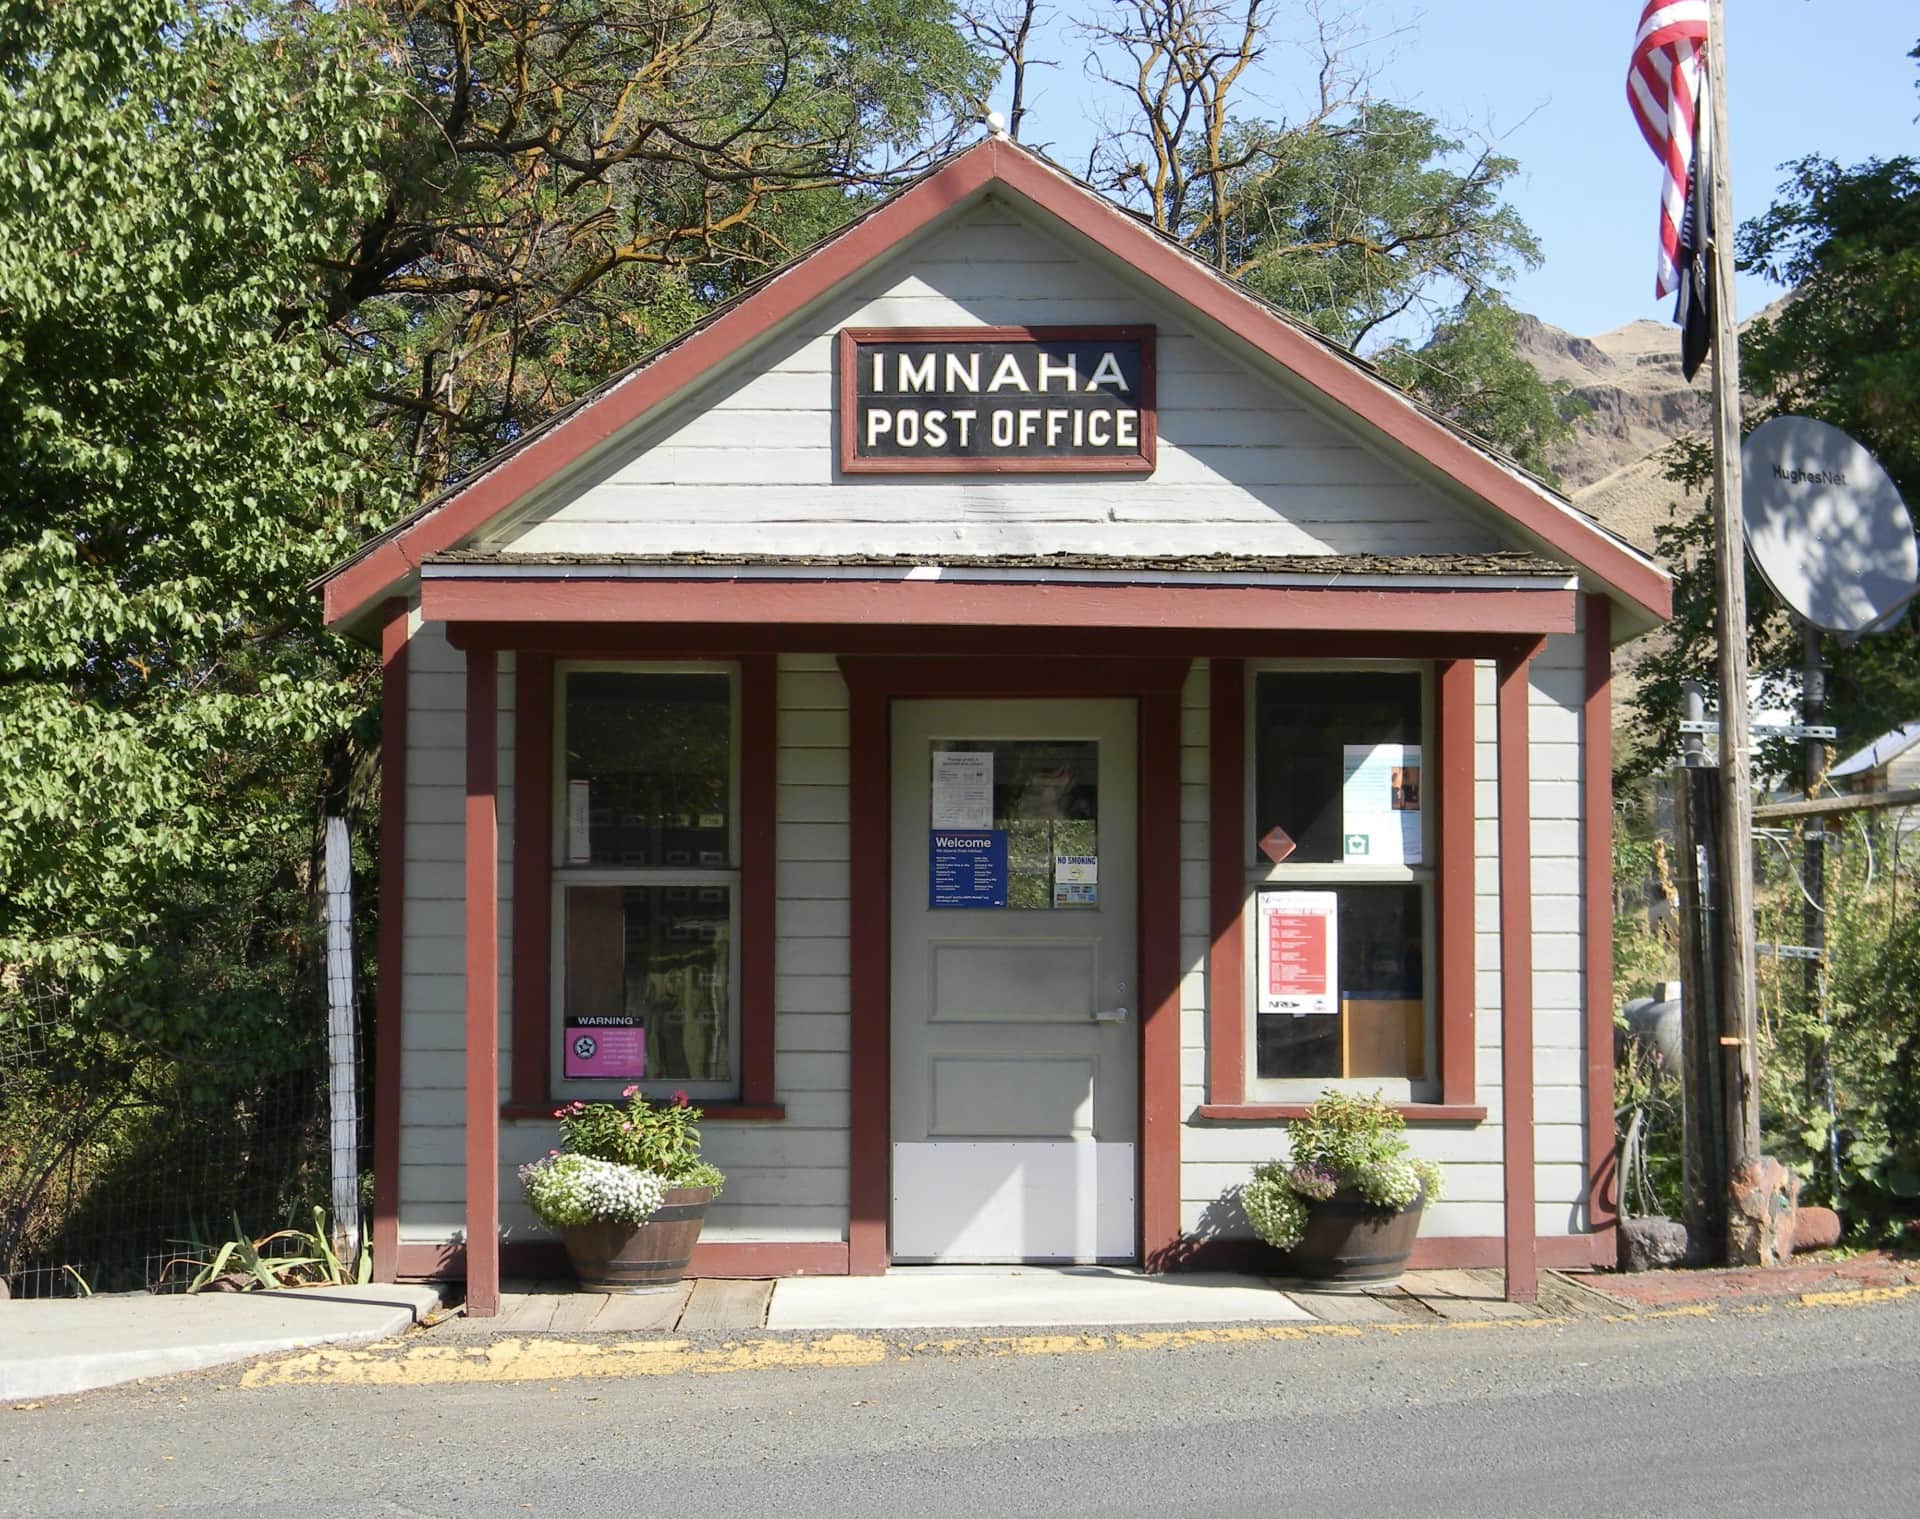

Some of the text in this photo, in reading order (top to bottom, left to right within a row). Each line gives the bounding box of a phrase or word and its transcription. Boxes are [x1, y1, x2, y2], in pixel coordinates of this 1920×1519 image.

[872, 352, 1130, 393] IMNAHA
[866, 408, 1138, 447] POST OFFICE
[1771, 463, 1847, 486] HughesNet
[935, 836, 992, 848] Welcome
[1057, 856, 1096, 865] NO SMOKING
[577, 1016, 634, 1025] WARNING
